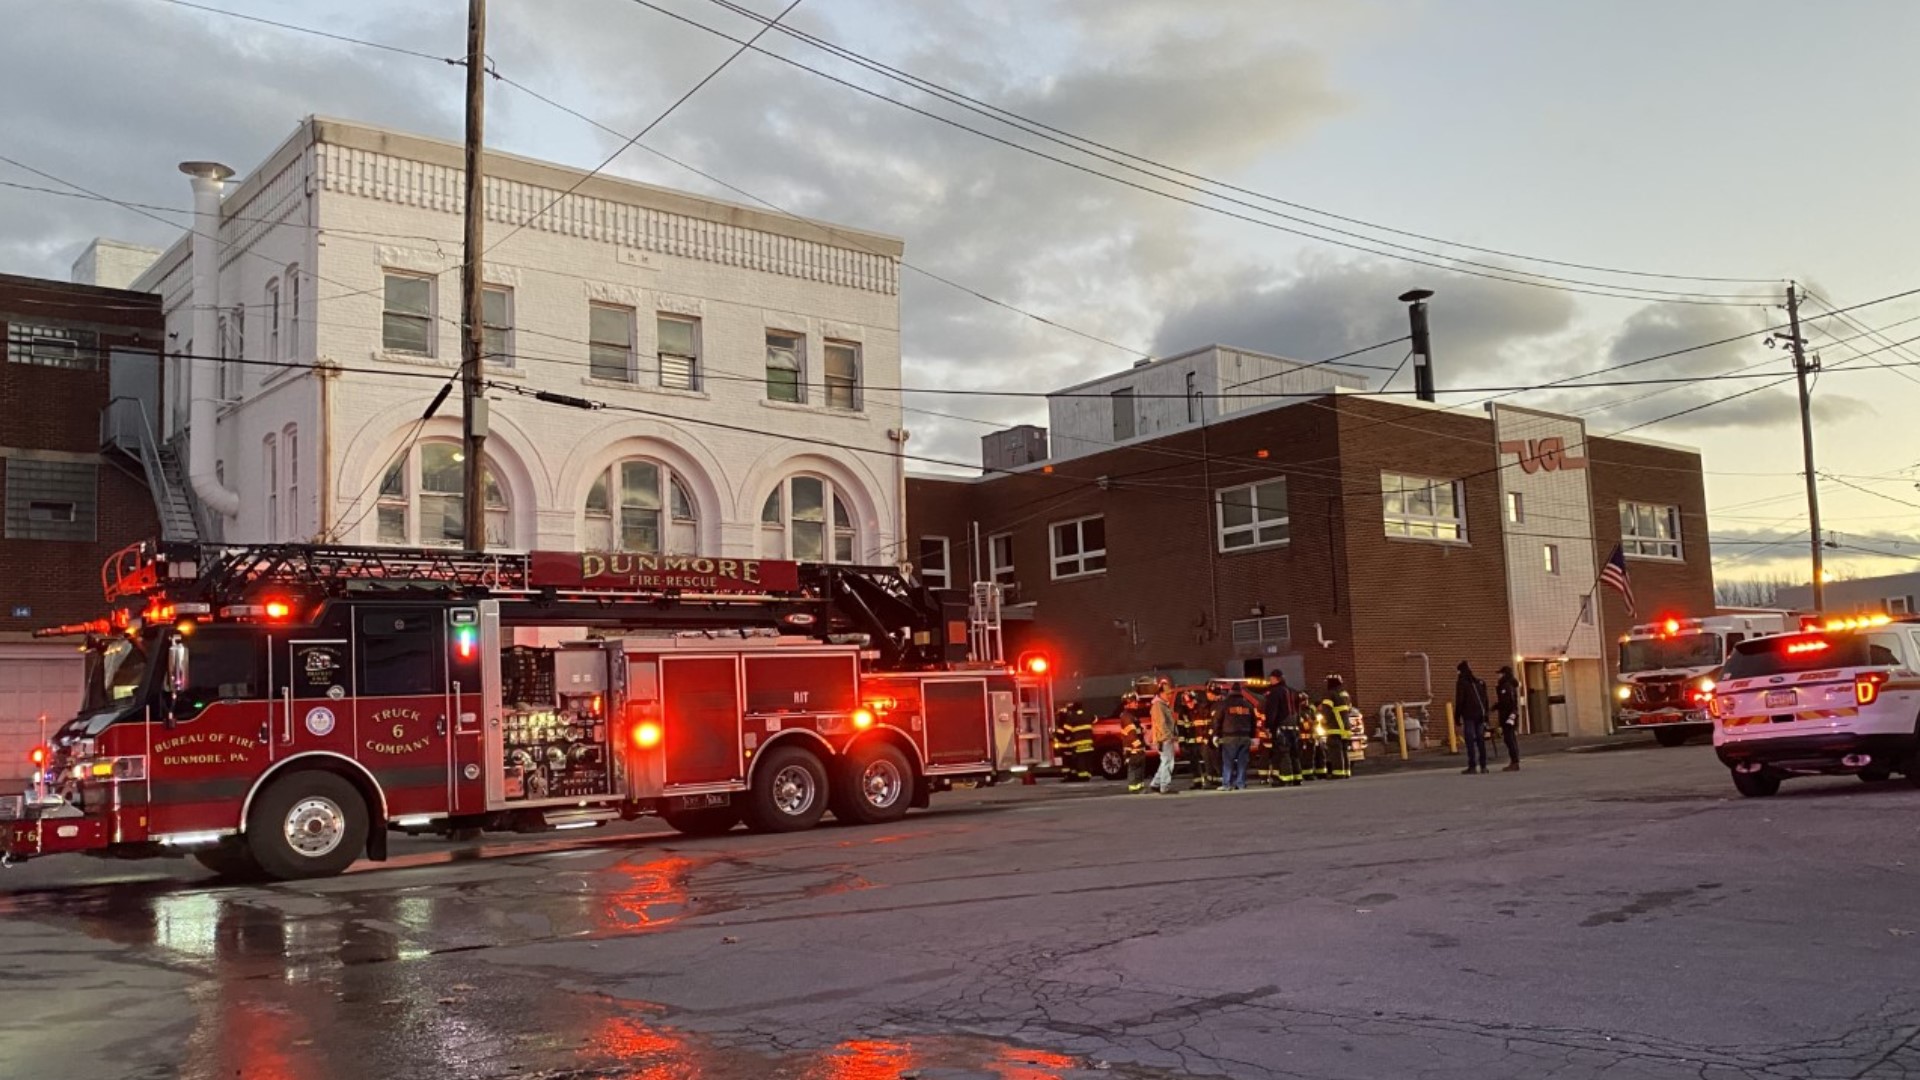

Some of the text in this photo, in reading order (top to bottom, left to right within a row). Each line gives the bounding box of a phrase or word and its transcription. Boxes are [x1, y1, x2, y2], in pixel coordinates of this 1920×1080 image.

[1500, 436, 1586, 474] UGL
[582, 554, 761, 584] DUNMORE
[793, 690, 809, 704] RIT
[371, 708, 420, 723] TRUCK
[392, 724, 404, 738] 6
[154, 733, 256, 753] BUREAU OF FIRE
[366, 736, 430, 754] COMPANY
